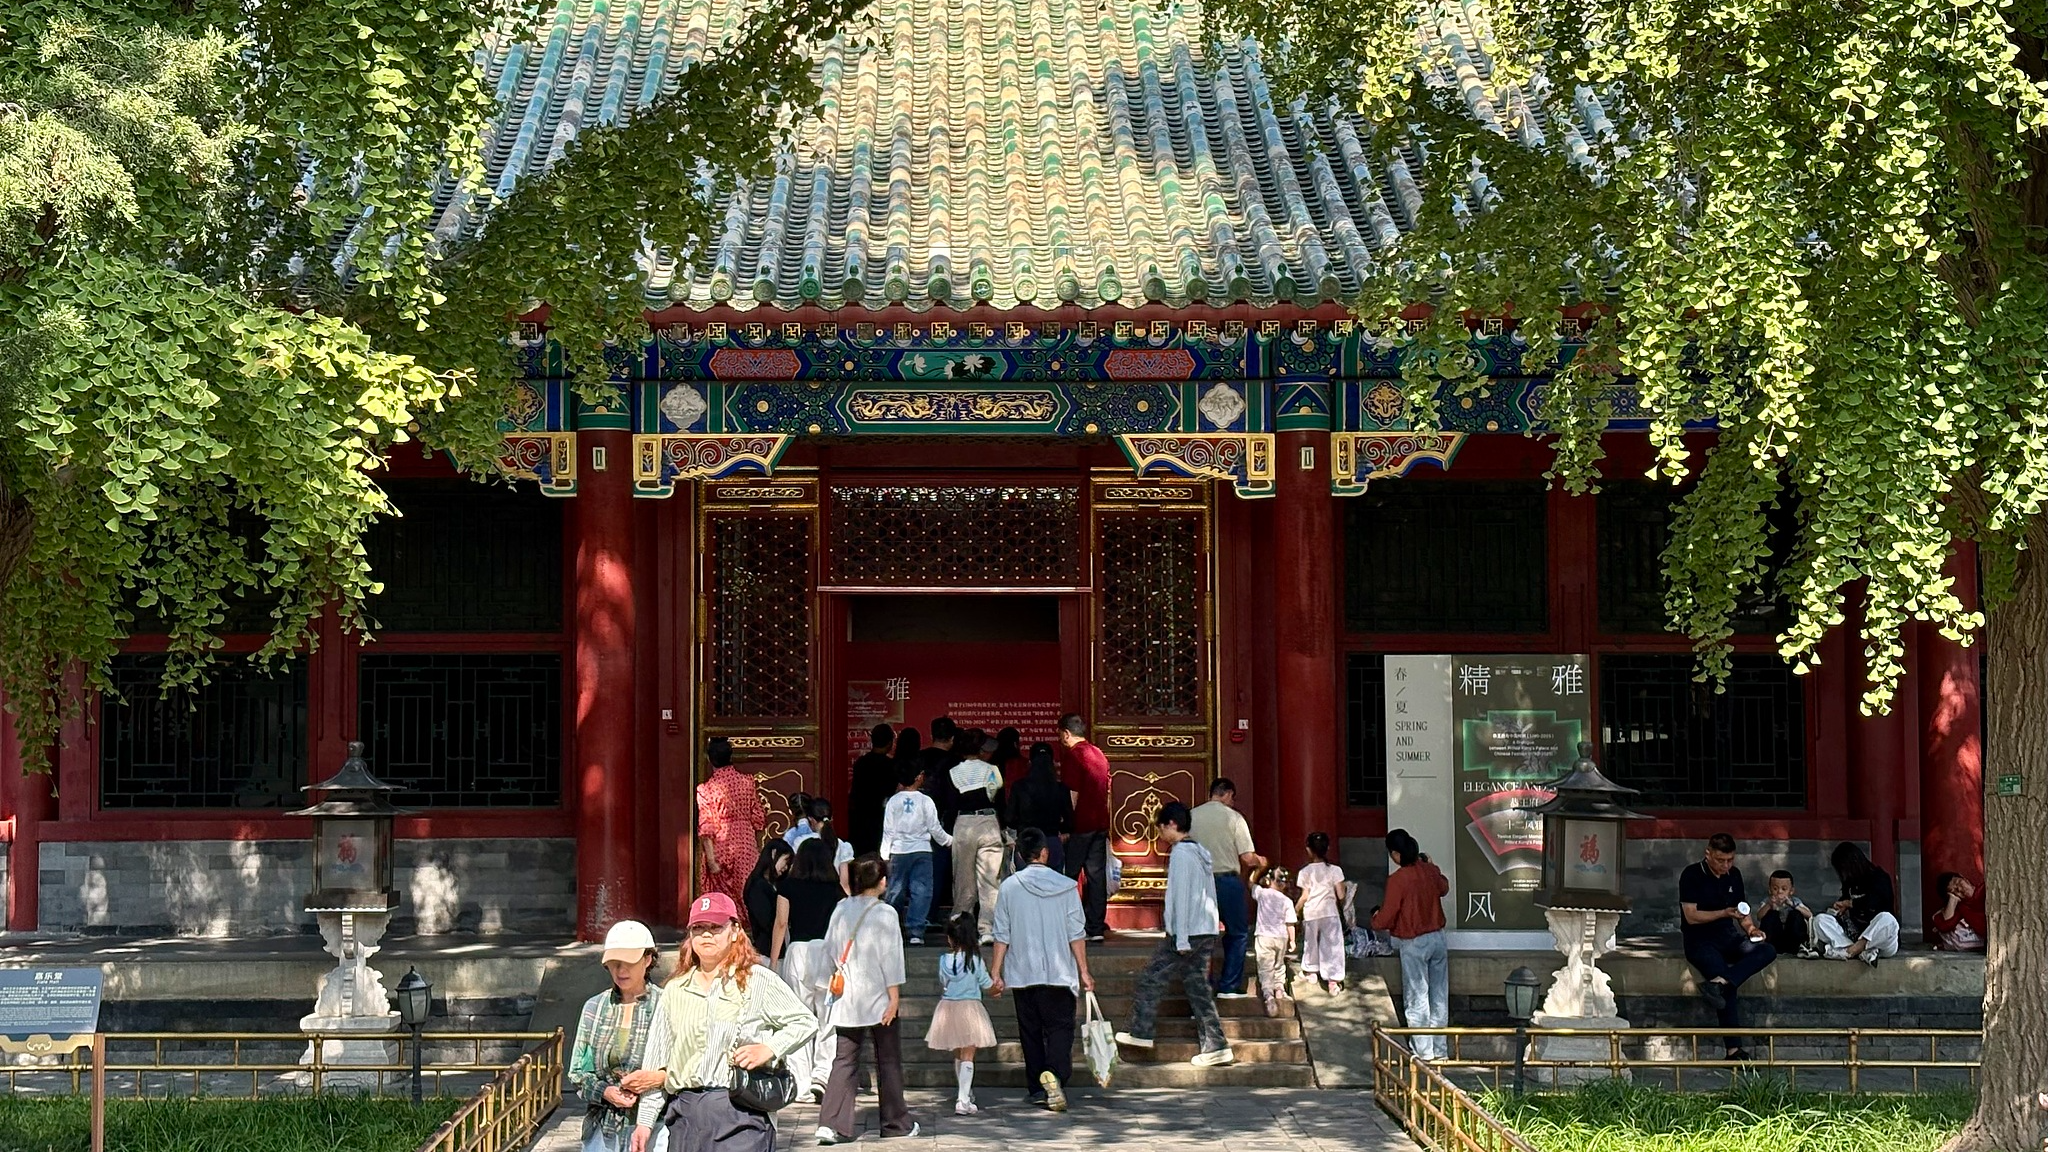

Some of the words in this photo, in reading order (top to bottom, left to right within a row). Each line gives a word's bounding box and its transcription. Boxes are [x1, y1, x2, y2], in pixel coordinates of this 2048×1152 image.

[1459, 664, 1491, 696] 精
[1551, 664, 1584, 696] 雅
[886, 677, 910, 701] 雅
[1395, 721, 1428, 732] SPRING
[1395, 736, 1414, 747] AND
[1395, 751, 1431, 762] SUMMER
[1463, 782, 1520, 792] ELEGANCE
[700, 898, 711, 911] B
[1465, 891, 1496, 923] 风
